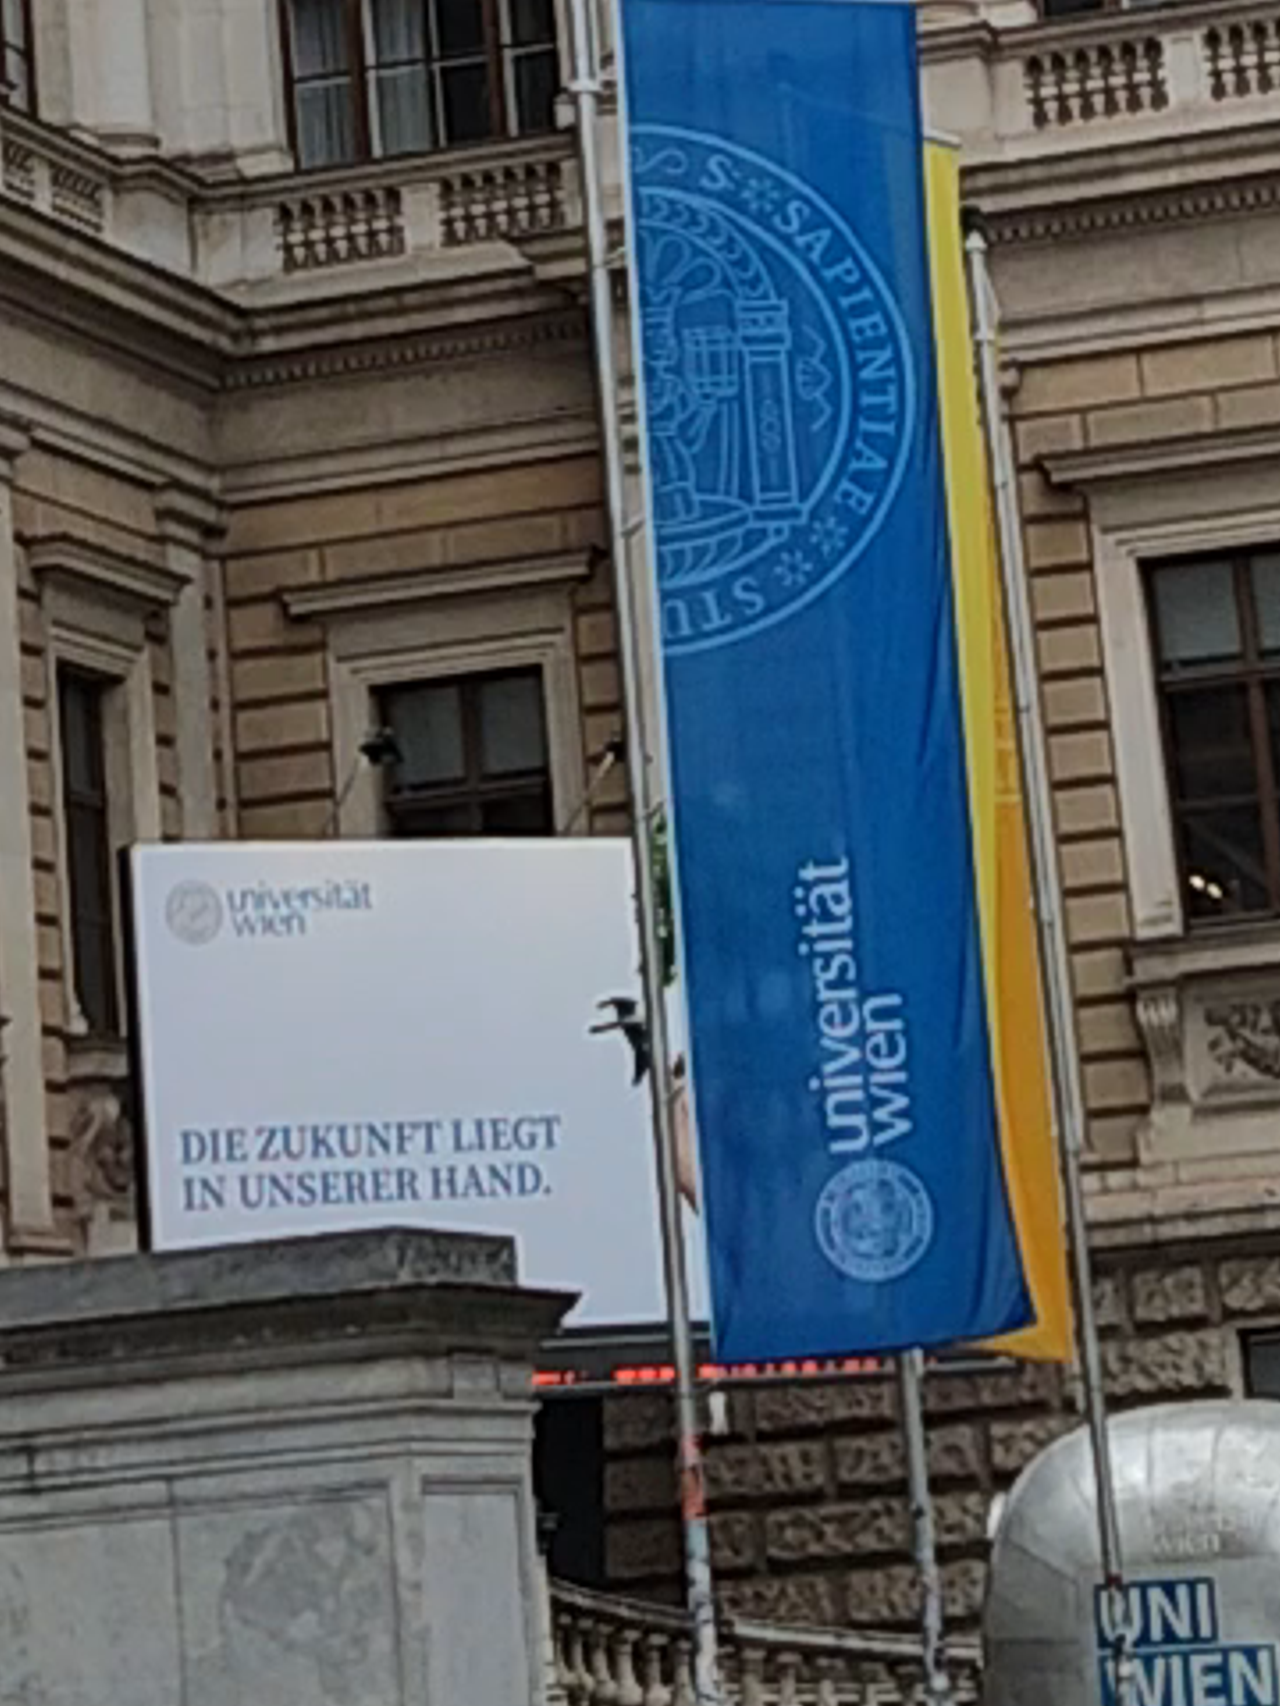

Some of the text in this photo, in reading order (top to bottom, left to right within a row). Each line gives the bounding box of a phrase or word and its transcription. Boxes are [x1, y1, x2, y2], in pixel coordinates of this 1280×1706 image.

[773, 199, 896, 515] SAPIENTIAE
[226, 878, 373, 913] universität
[230, 913, 307, 937] wien
[794, 855, 870, 1153] universität
[863, 992, 913, 1146] wien
[180, 1115, 562, 1165] DIE ZUKUNFT LIEGT
[182, 1161, 552, 1212] IN UNSERER HAND.
[1100, 1582, 1213, 1647] UNI
